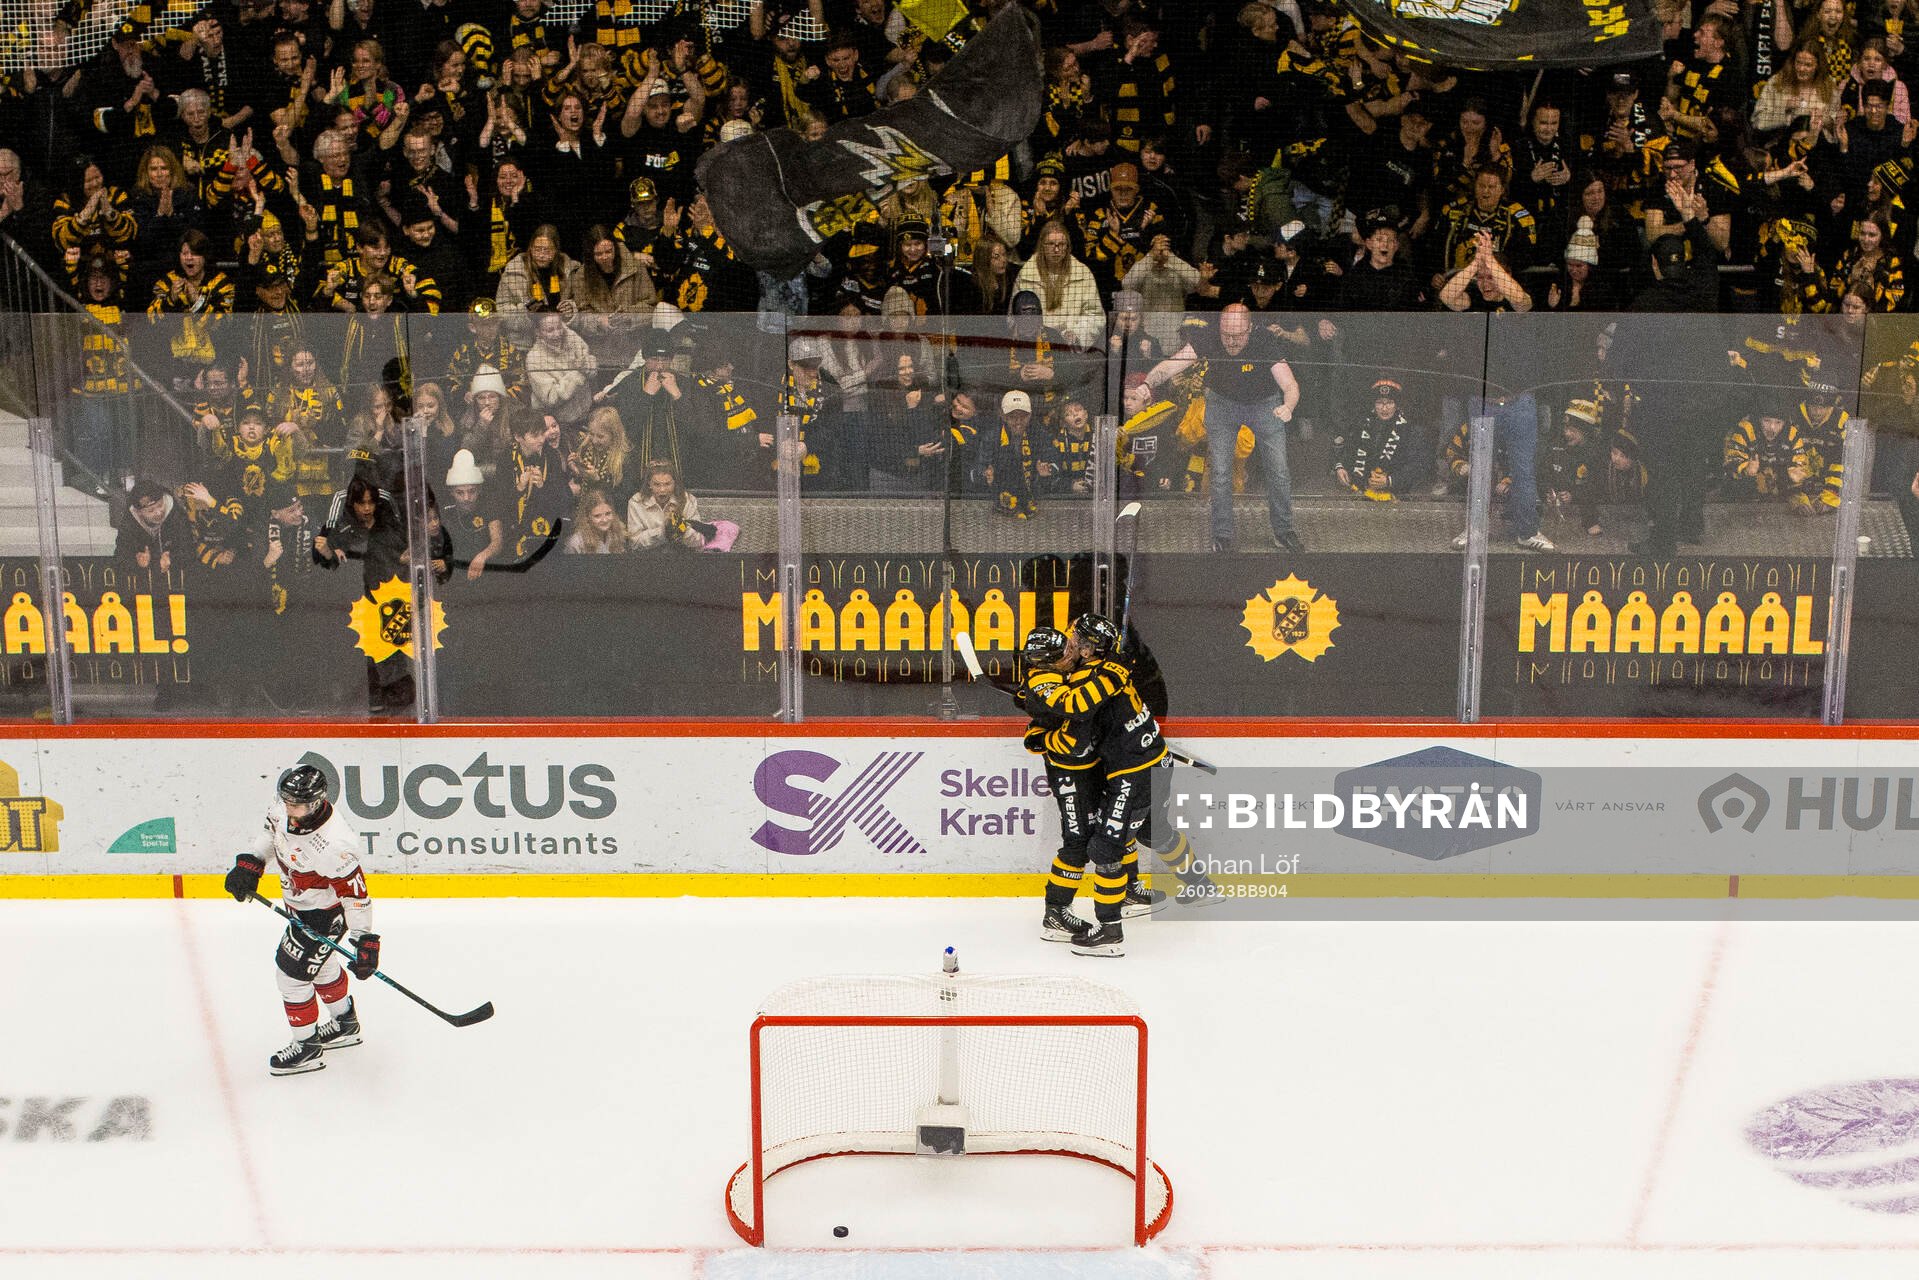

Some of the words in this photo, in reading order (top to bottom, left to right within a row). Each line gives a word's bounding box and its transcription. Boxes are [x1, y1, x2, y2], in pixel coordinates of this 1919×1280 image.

[940, 768, 1053, 798] Skelle
[1111, 779, 1132, 819] REPAY
[1555, 799, 1595, 811] VÅRT
[1602, 802, 1665, 811] ANSVAR
[941, 808, 1035, 836] Kraft
[1065, 795, 1080, 834] REPAY
[396, 831, 618, 855] Consultants
[0, 1095, 153, 1143] KA
